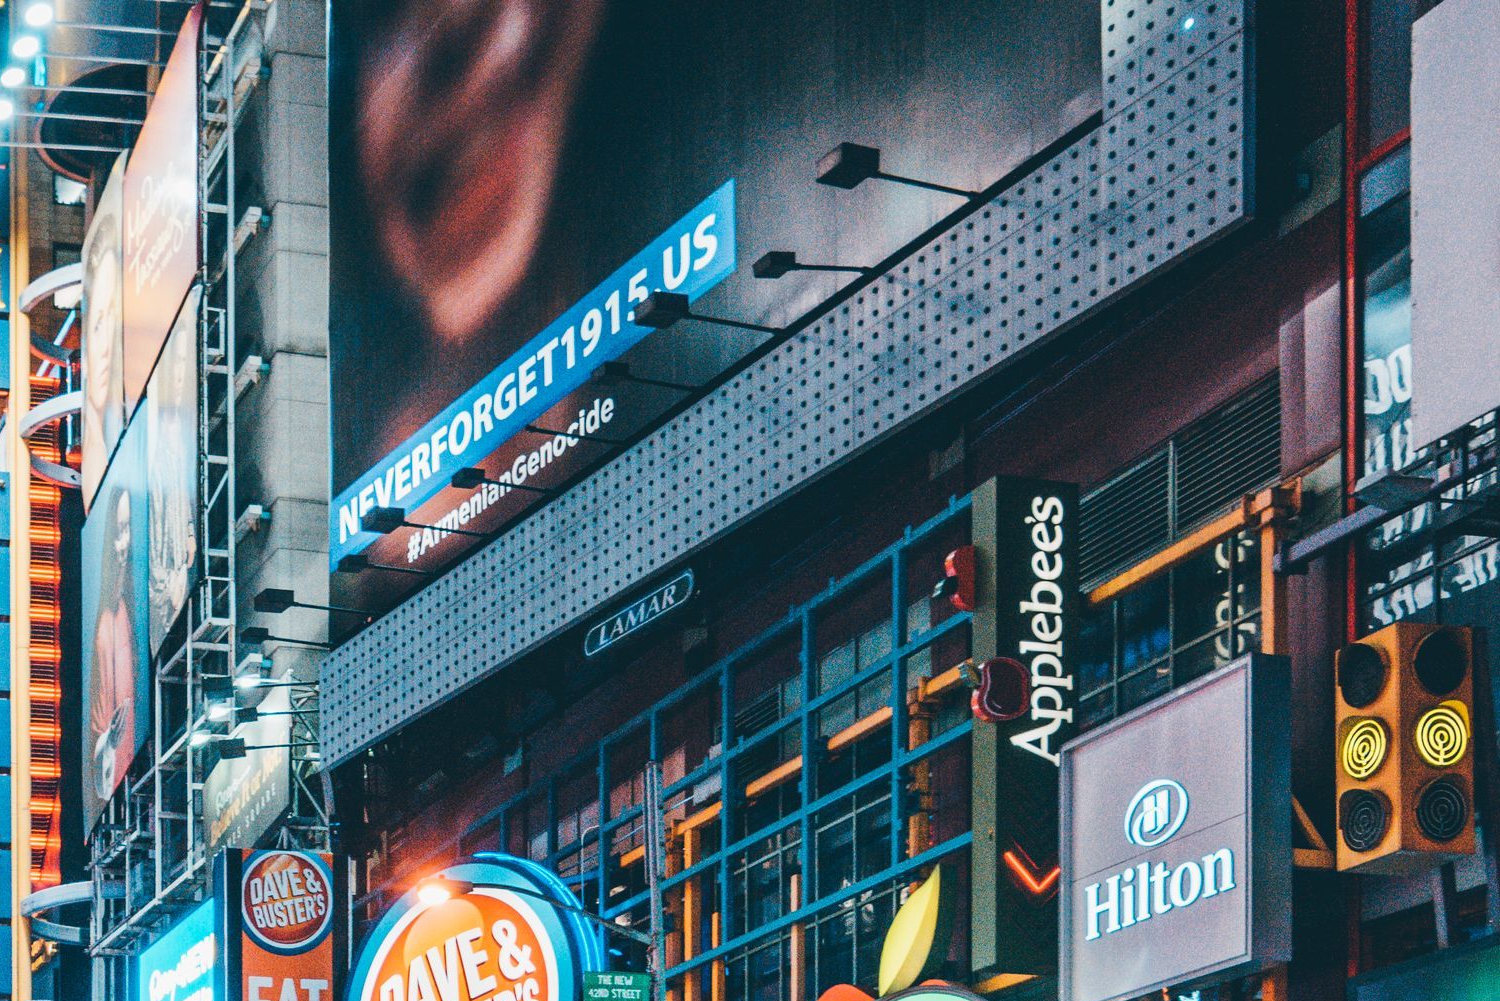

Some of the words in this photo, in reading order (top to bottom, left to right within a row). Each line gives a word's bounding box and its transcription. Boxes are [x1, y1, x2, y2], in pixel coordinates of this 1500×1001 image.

[406, 394, 615, 564] #ArmenianGenocide
[596, 585, 676, 648] LAMAR
[1010, 496, 1074, 767] Applebee's
[250, 868, 302, 903] DAVE
[303, 866, 322, 891] &
[253, 894, 326, 930] BUSTER'S
[1084, 844, 1236, 942] Hilton
[490, 918, 537, 982] &
[614, 974, 634, 986] NEW
[611, 988, 642, 1000] STREET
